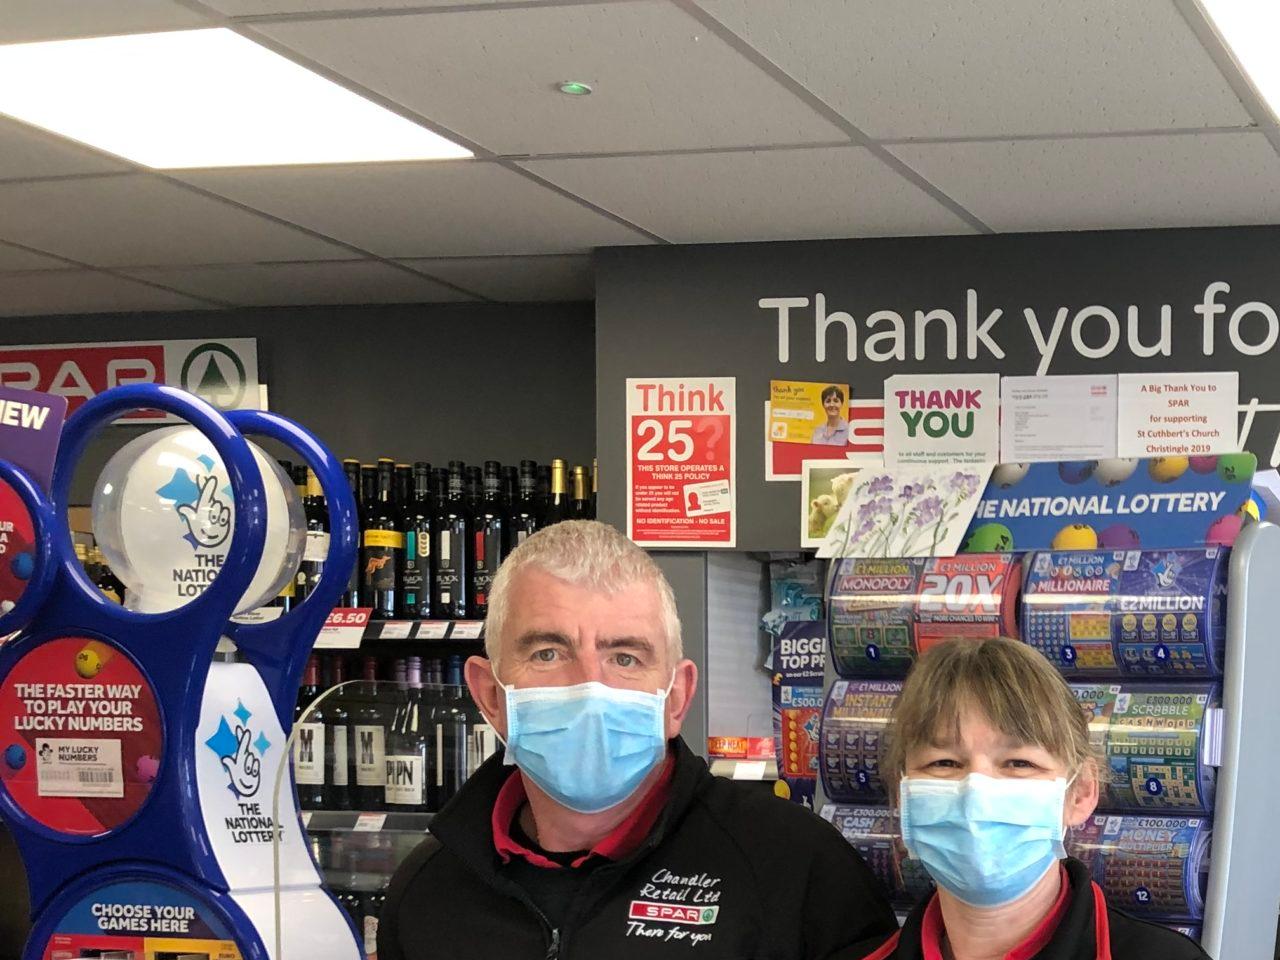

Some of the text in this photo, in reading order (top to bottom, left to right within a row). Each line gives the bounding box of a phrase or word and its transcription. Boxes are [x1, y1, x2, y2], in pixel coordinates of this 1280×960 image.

[758, 288, 1004, 363] Thank
[1022, 304, 1174, 376] you
[1149, 384, 1205, 395] Big Thank You
[635, 383, 725, 412] Think
[895, 389, 982, 409] THANK
[1168, 399, 1189, 407] SPAR
[900, 410, 975, 439] YOU
[1164, 414, 1207, 424] supporting
[1191, 429, 1219, 439] Church
[1001, 491, 1226, 518] NATIONAL LOTTERY
[842, 578, 912, 590] MONOPOLY
[1038, 579, 1110, 592] MILLIONAIRE
[920, 574, 1002, 612] 20X
[781, 656, 809, 669] TOP
[15, 684, 142, 699] THE FASTER WAY
[24, 700, 132, 716] TO PLAY YOUR
[1132, 705, 1189, 716] SCRABBLE
[14, 716, 143, 731] LUCKY NUMBERS
[238, 803, 261, 815] THE
[1121, 831, 1177, 841] MONEY
[652, 868, 721, 888] Chandler
[640, 883, 721, 902] Retail Ltd
[91, 903, 195, 921] CHOOSE YOUR
[646, 906, 699, 920] SPAR
[98, 917, 189, 933] GAMES HERE
[626, 921, 664, 937] There
